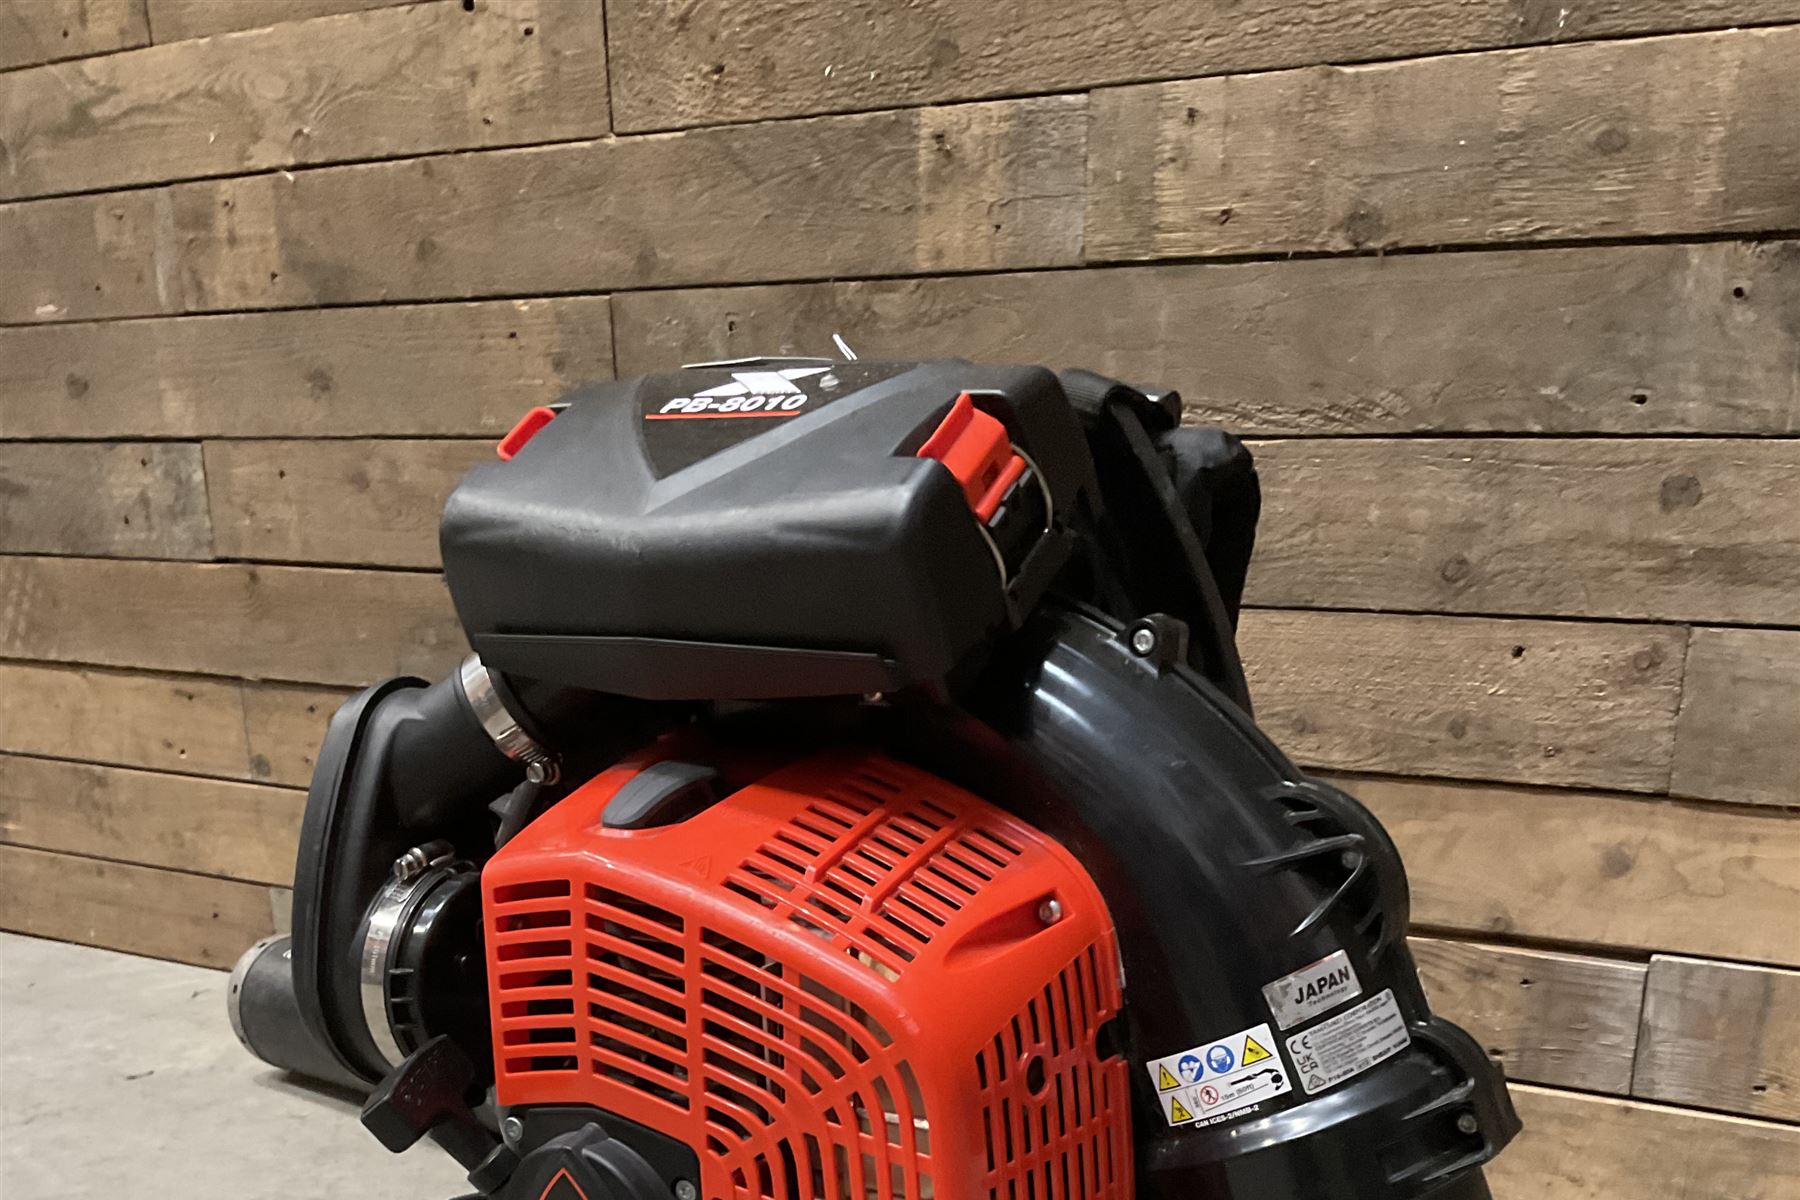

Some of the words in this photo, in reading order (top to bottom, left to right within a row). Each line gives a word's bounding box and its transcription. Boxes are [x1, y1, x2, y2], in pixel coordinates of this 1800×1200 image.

[660, 394, 808, 414] PB-8010
[1294, 965, 1350, 1005] JAPAN
[1194, 1119, 1210, 1129] CAN
